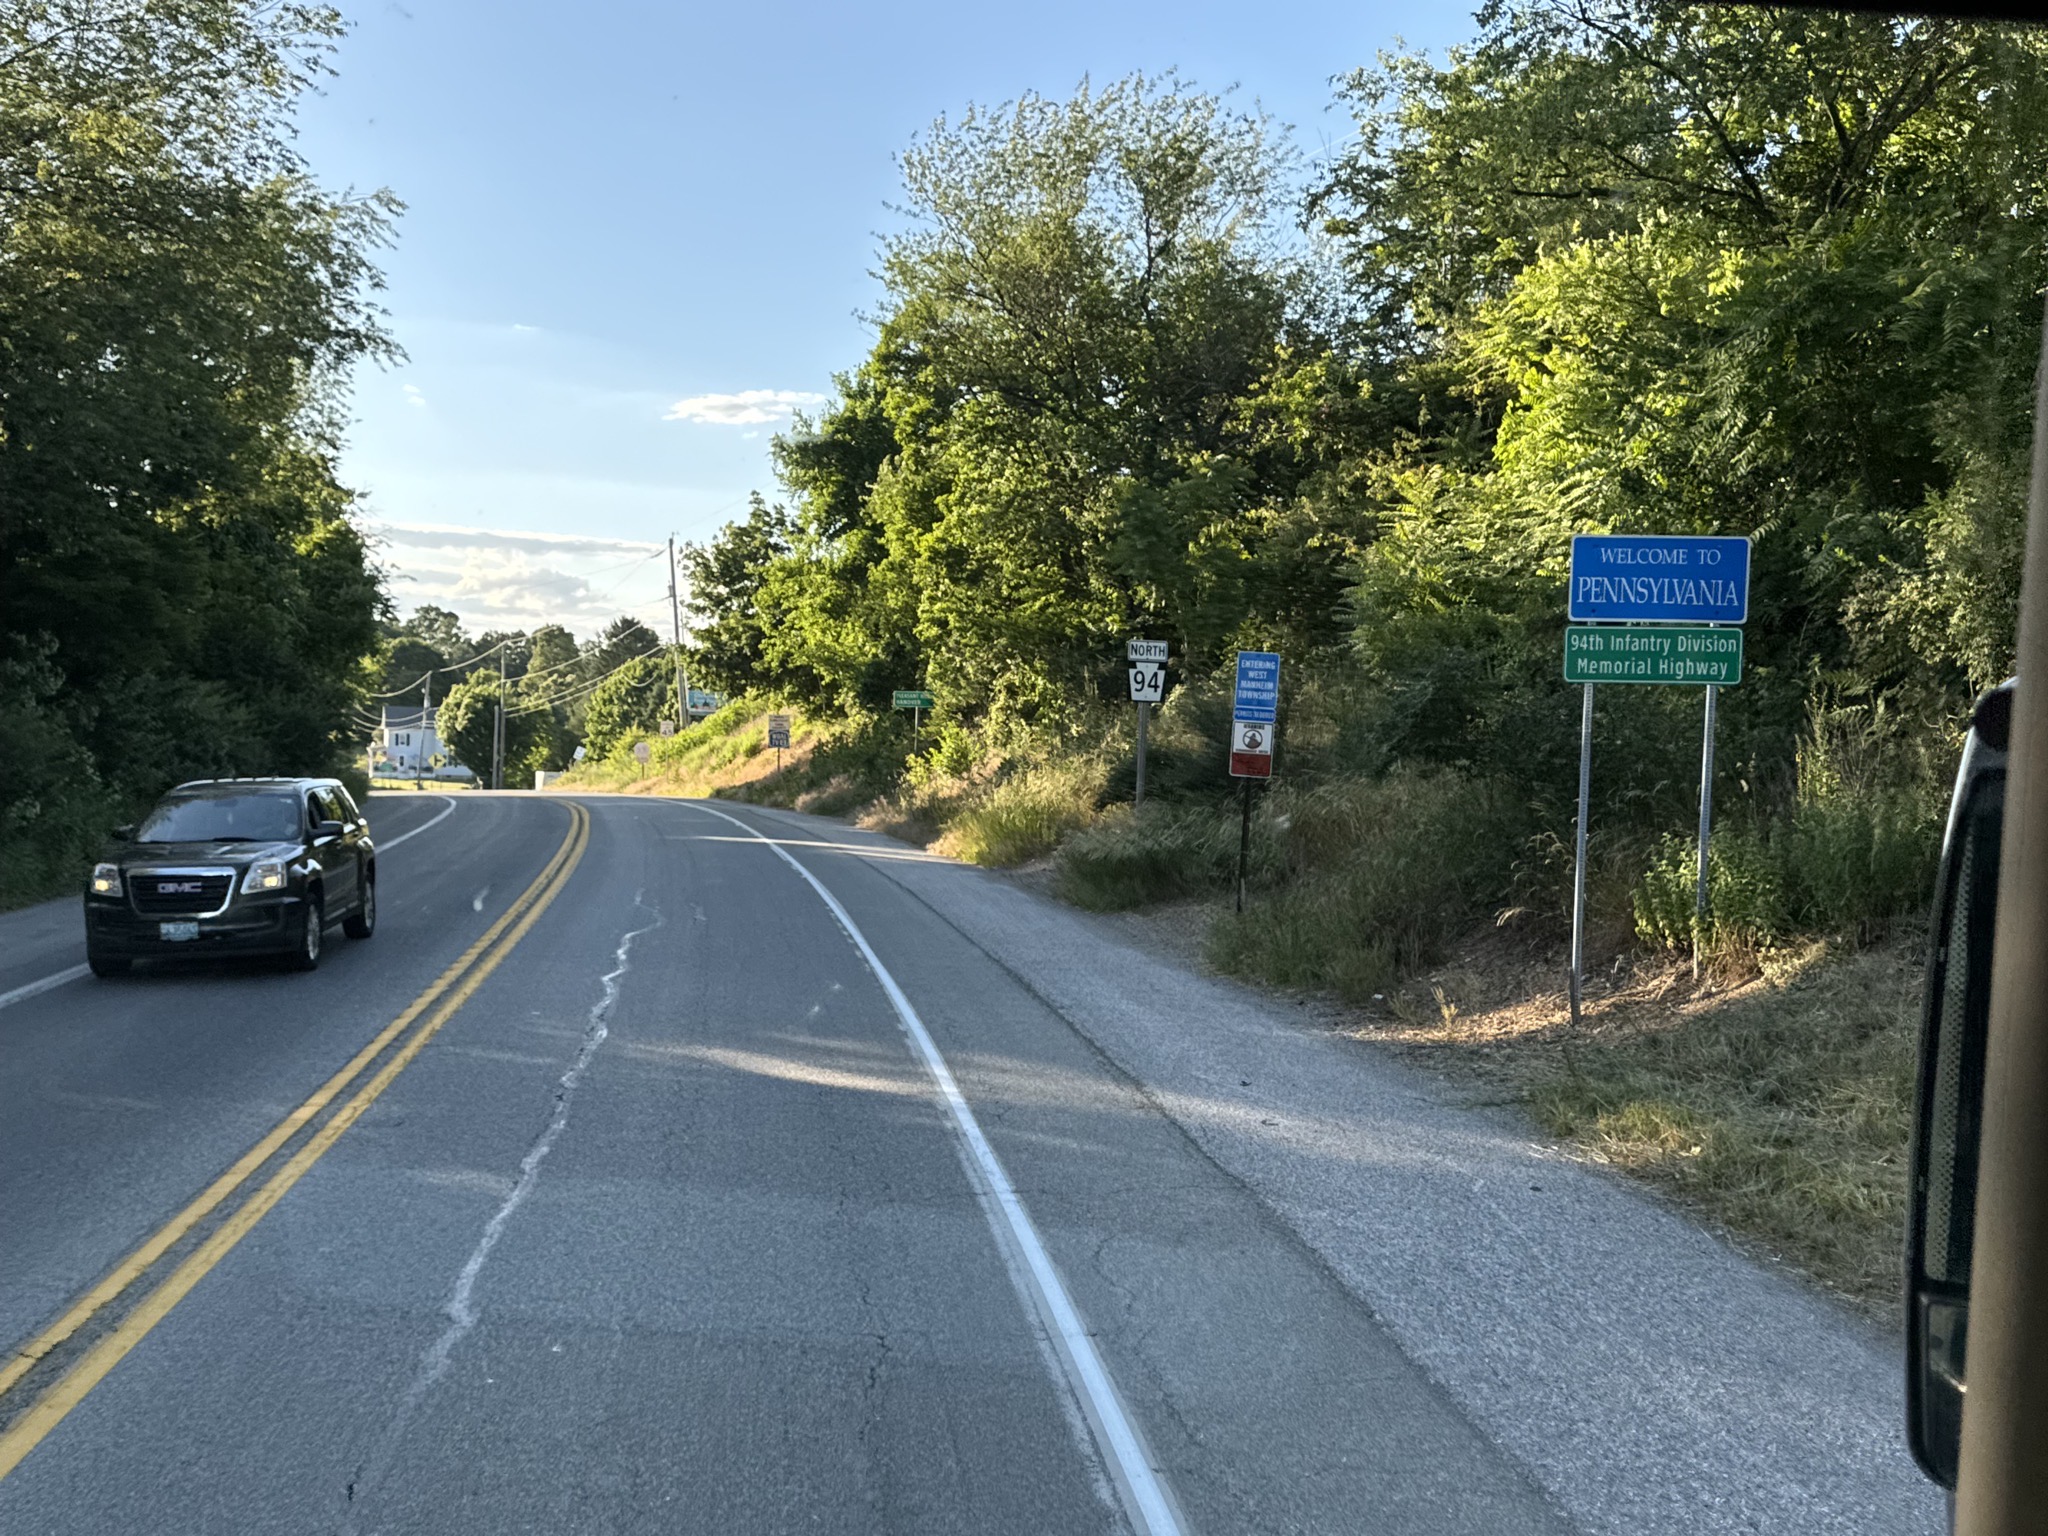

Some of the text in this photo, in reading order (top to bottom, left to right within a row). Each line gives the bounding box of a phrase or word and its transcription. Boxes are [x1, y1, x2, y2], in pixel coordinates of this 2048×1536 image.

[1601, 548, 1721, 565] WELCOME TO
[1576, 576, 1739, 606] PENNSYLVANIA
[1131, 644, 1165, 657] NORTH
[1571, 634, 1737, 656] 94th Infantry Division
[1241, 659, 1276, 670] ENTERING
[1577, 657, 1728, 680] Memorial Highway
[1134, 670, 1160, 693] 94
[1247, 670, 1268, 679] WEST
[1238, 689, 1276, 701] TOWNSHIP
[157, 882, 202, 893] GMC
